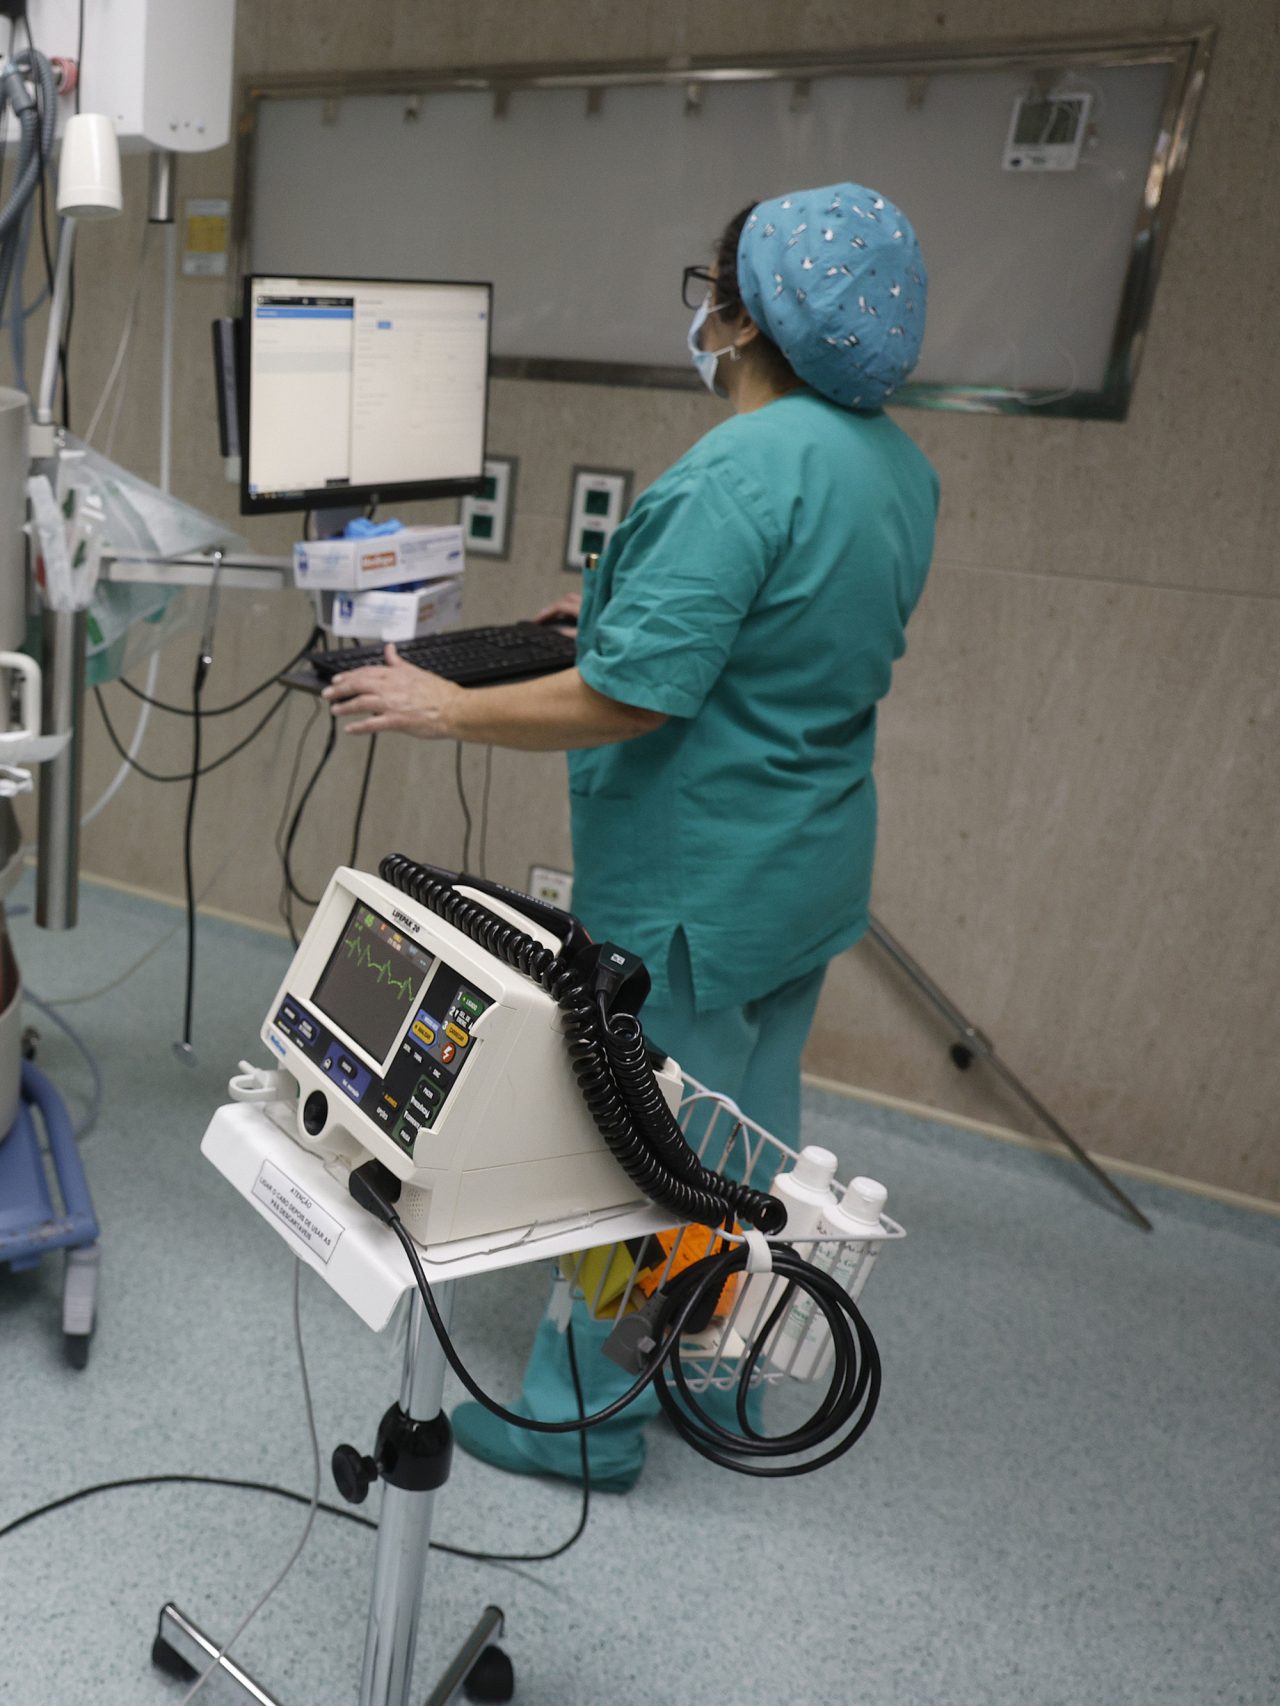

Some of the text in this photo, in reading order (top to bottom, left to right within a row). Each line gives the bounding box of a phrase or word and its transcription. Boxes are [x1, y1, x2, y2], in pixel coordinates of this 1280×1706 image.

[392, 909, 420, 933] LIFEPAK 20
[457, 991, 463, 1001] 1
[449, 1005, 456, 1017] 2
[441, 1020, 449, 1030] 3
[290, 1187, 313, 1209] ATENÇÃO
